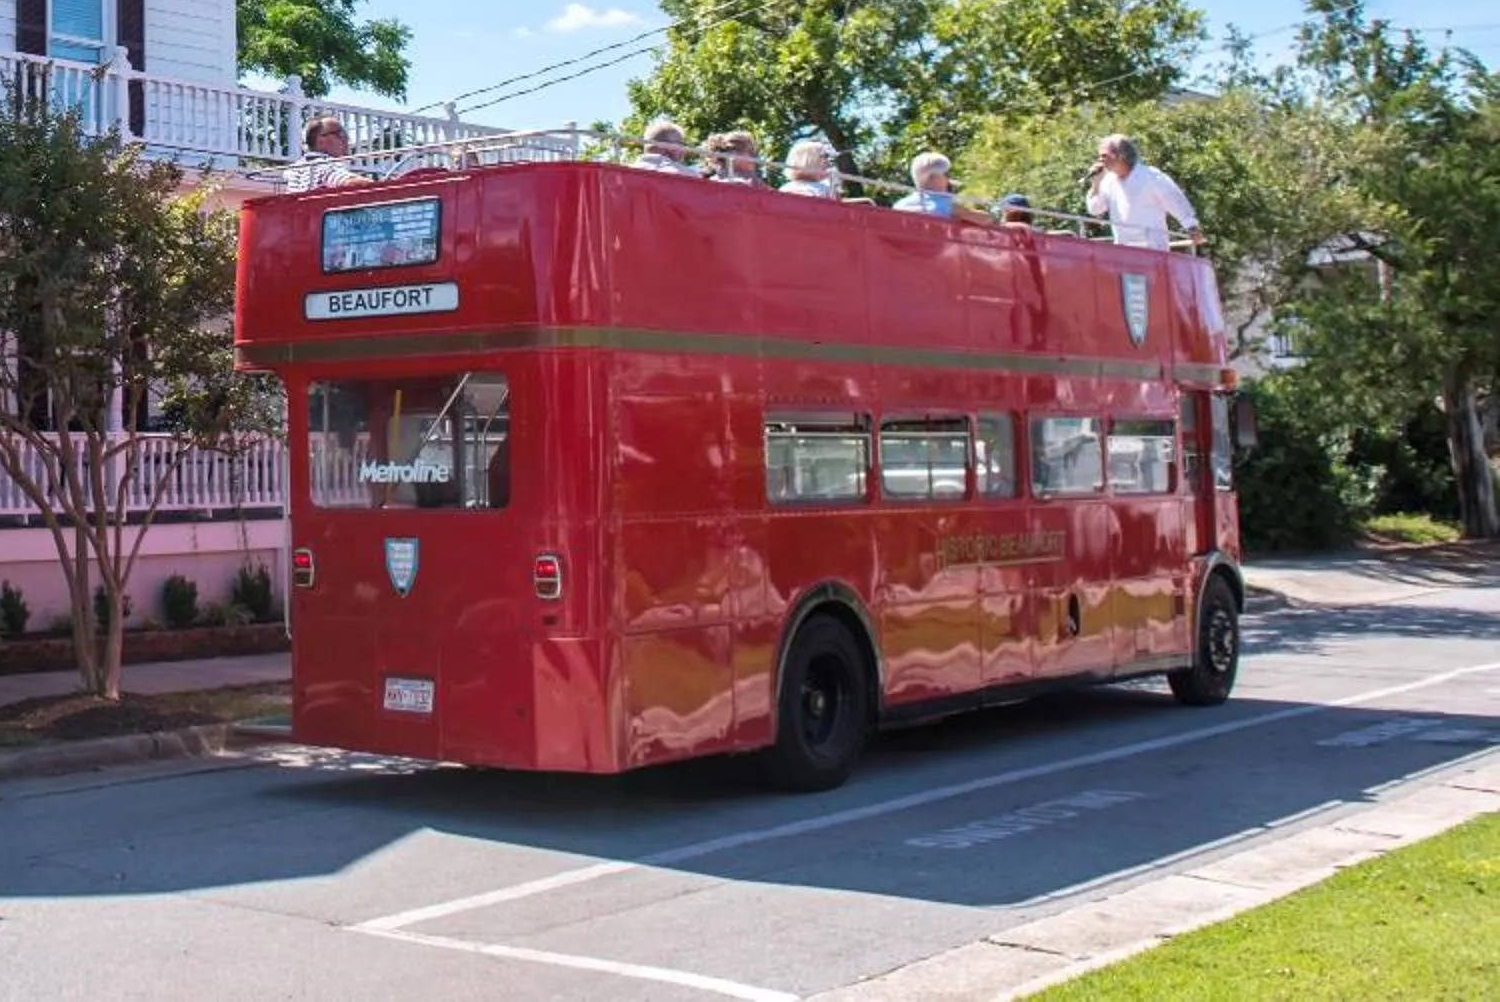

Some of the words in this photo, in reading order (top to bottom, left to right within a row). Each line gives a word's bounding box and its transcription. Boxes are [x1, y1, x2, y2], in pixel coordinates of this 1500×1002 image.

[329, 288, 434, 313] BEAUFORT
[360, 460, 449, 483] Metroline
[936, 534, 997, 569] HISTORIC
[999, 530, 1066, 558] BEAUFORT
